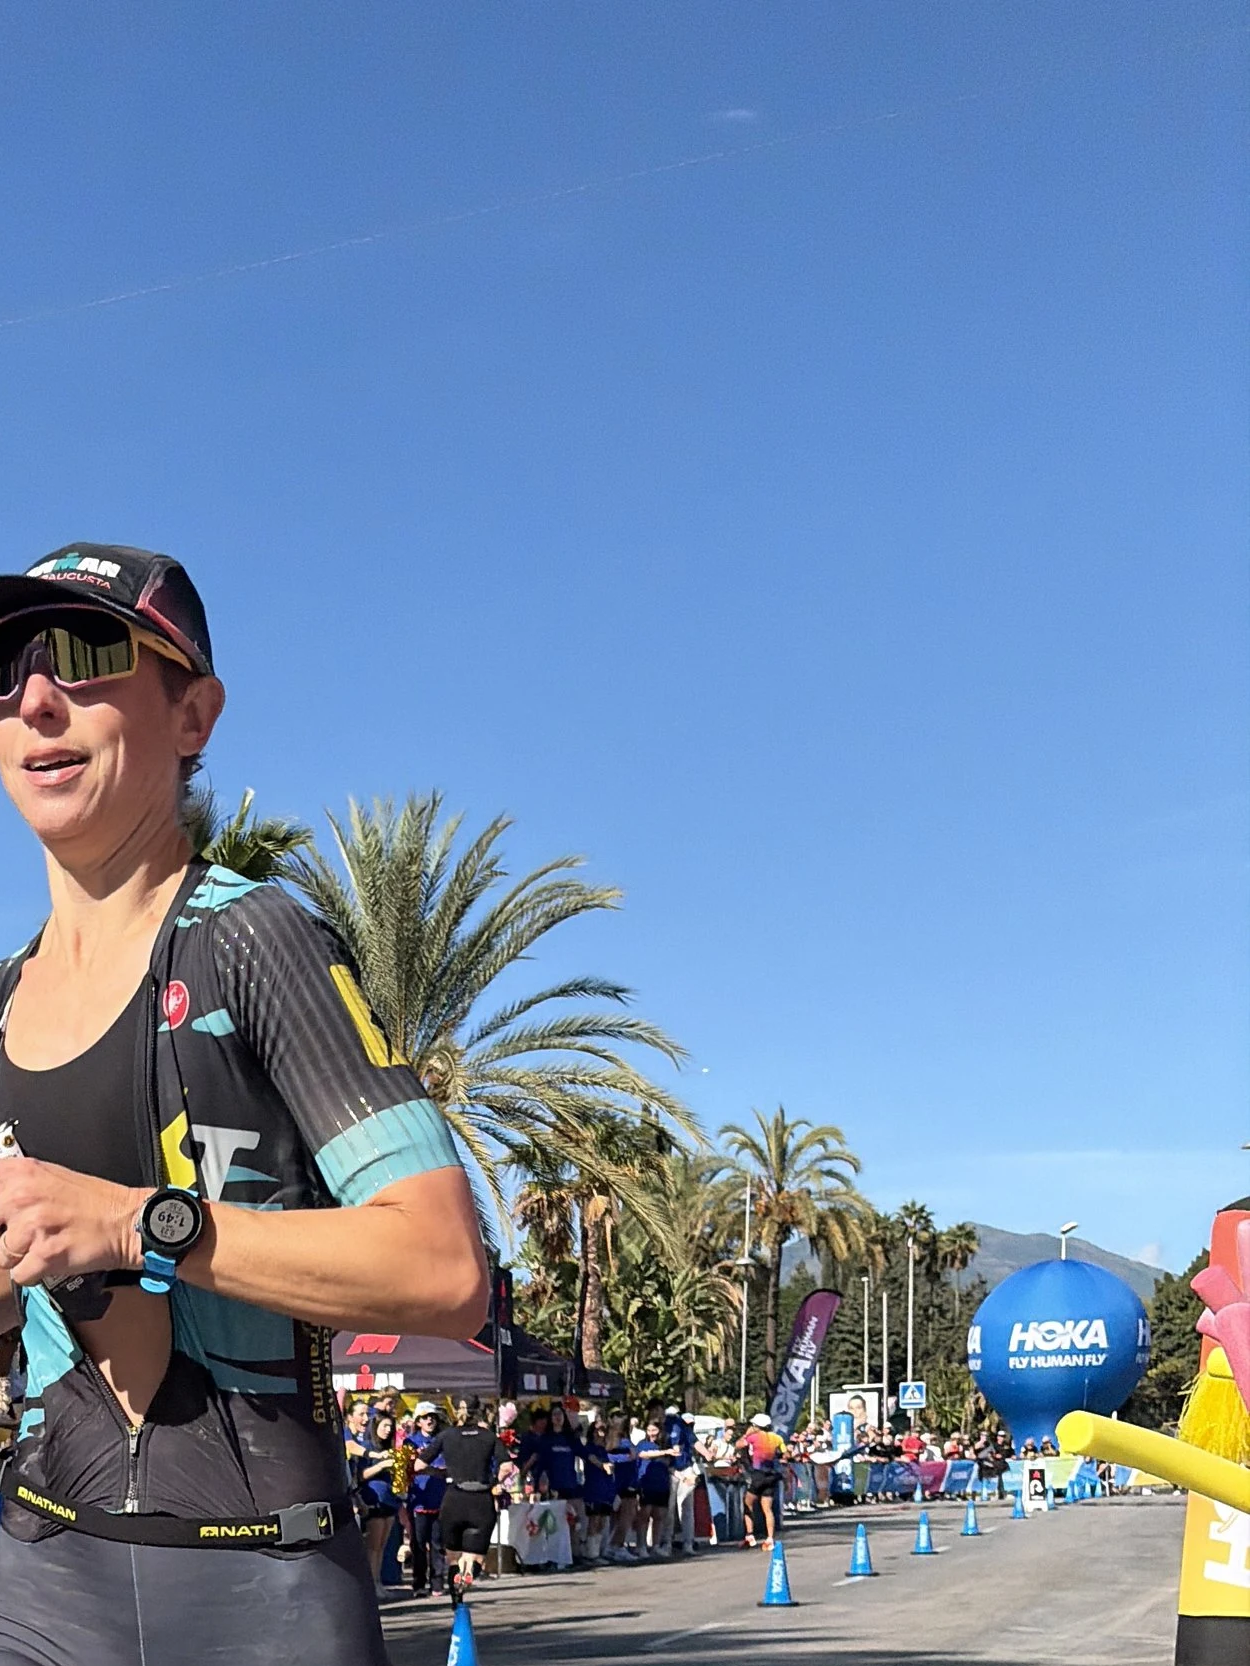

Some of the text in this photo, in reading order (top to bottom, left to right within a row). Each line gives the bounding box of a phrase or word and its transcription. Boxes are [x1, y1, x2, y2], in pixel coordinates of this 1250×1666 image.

[1008, 1318, 1110, 1353] HOKA
[1008, 1352, 1109, 1370] FLY HUMAN FLY
[26, 1490, 77, 1522] NATHAN
